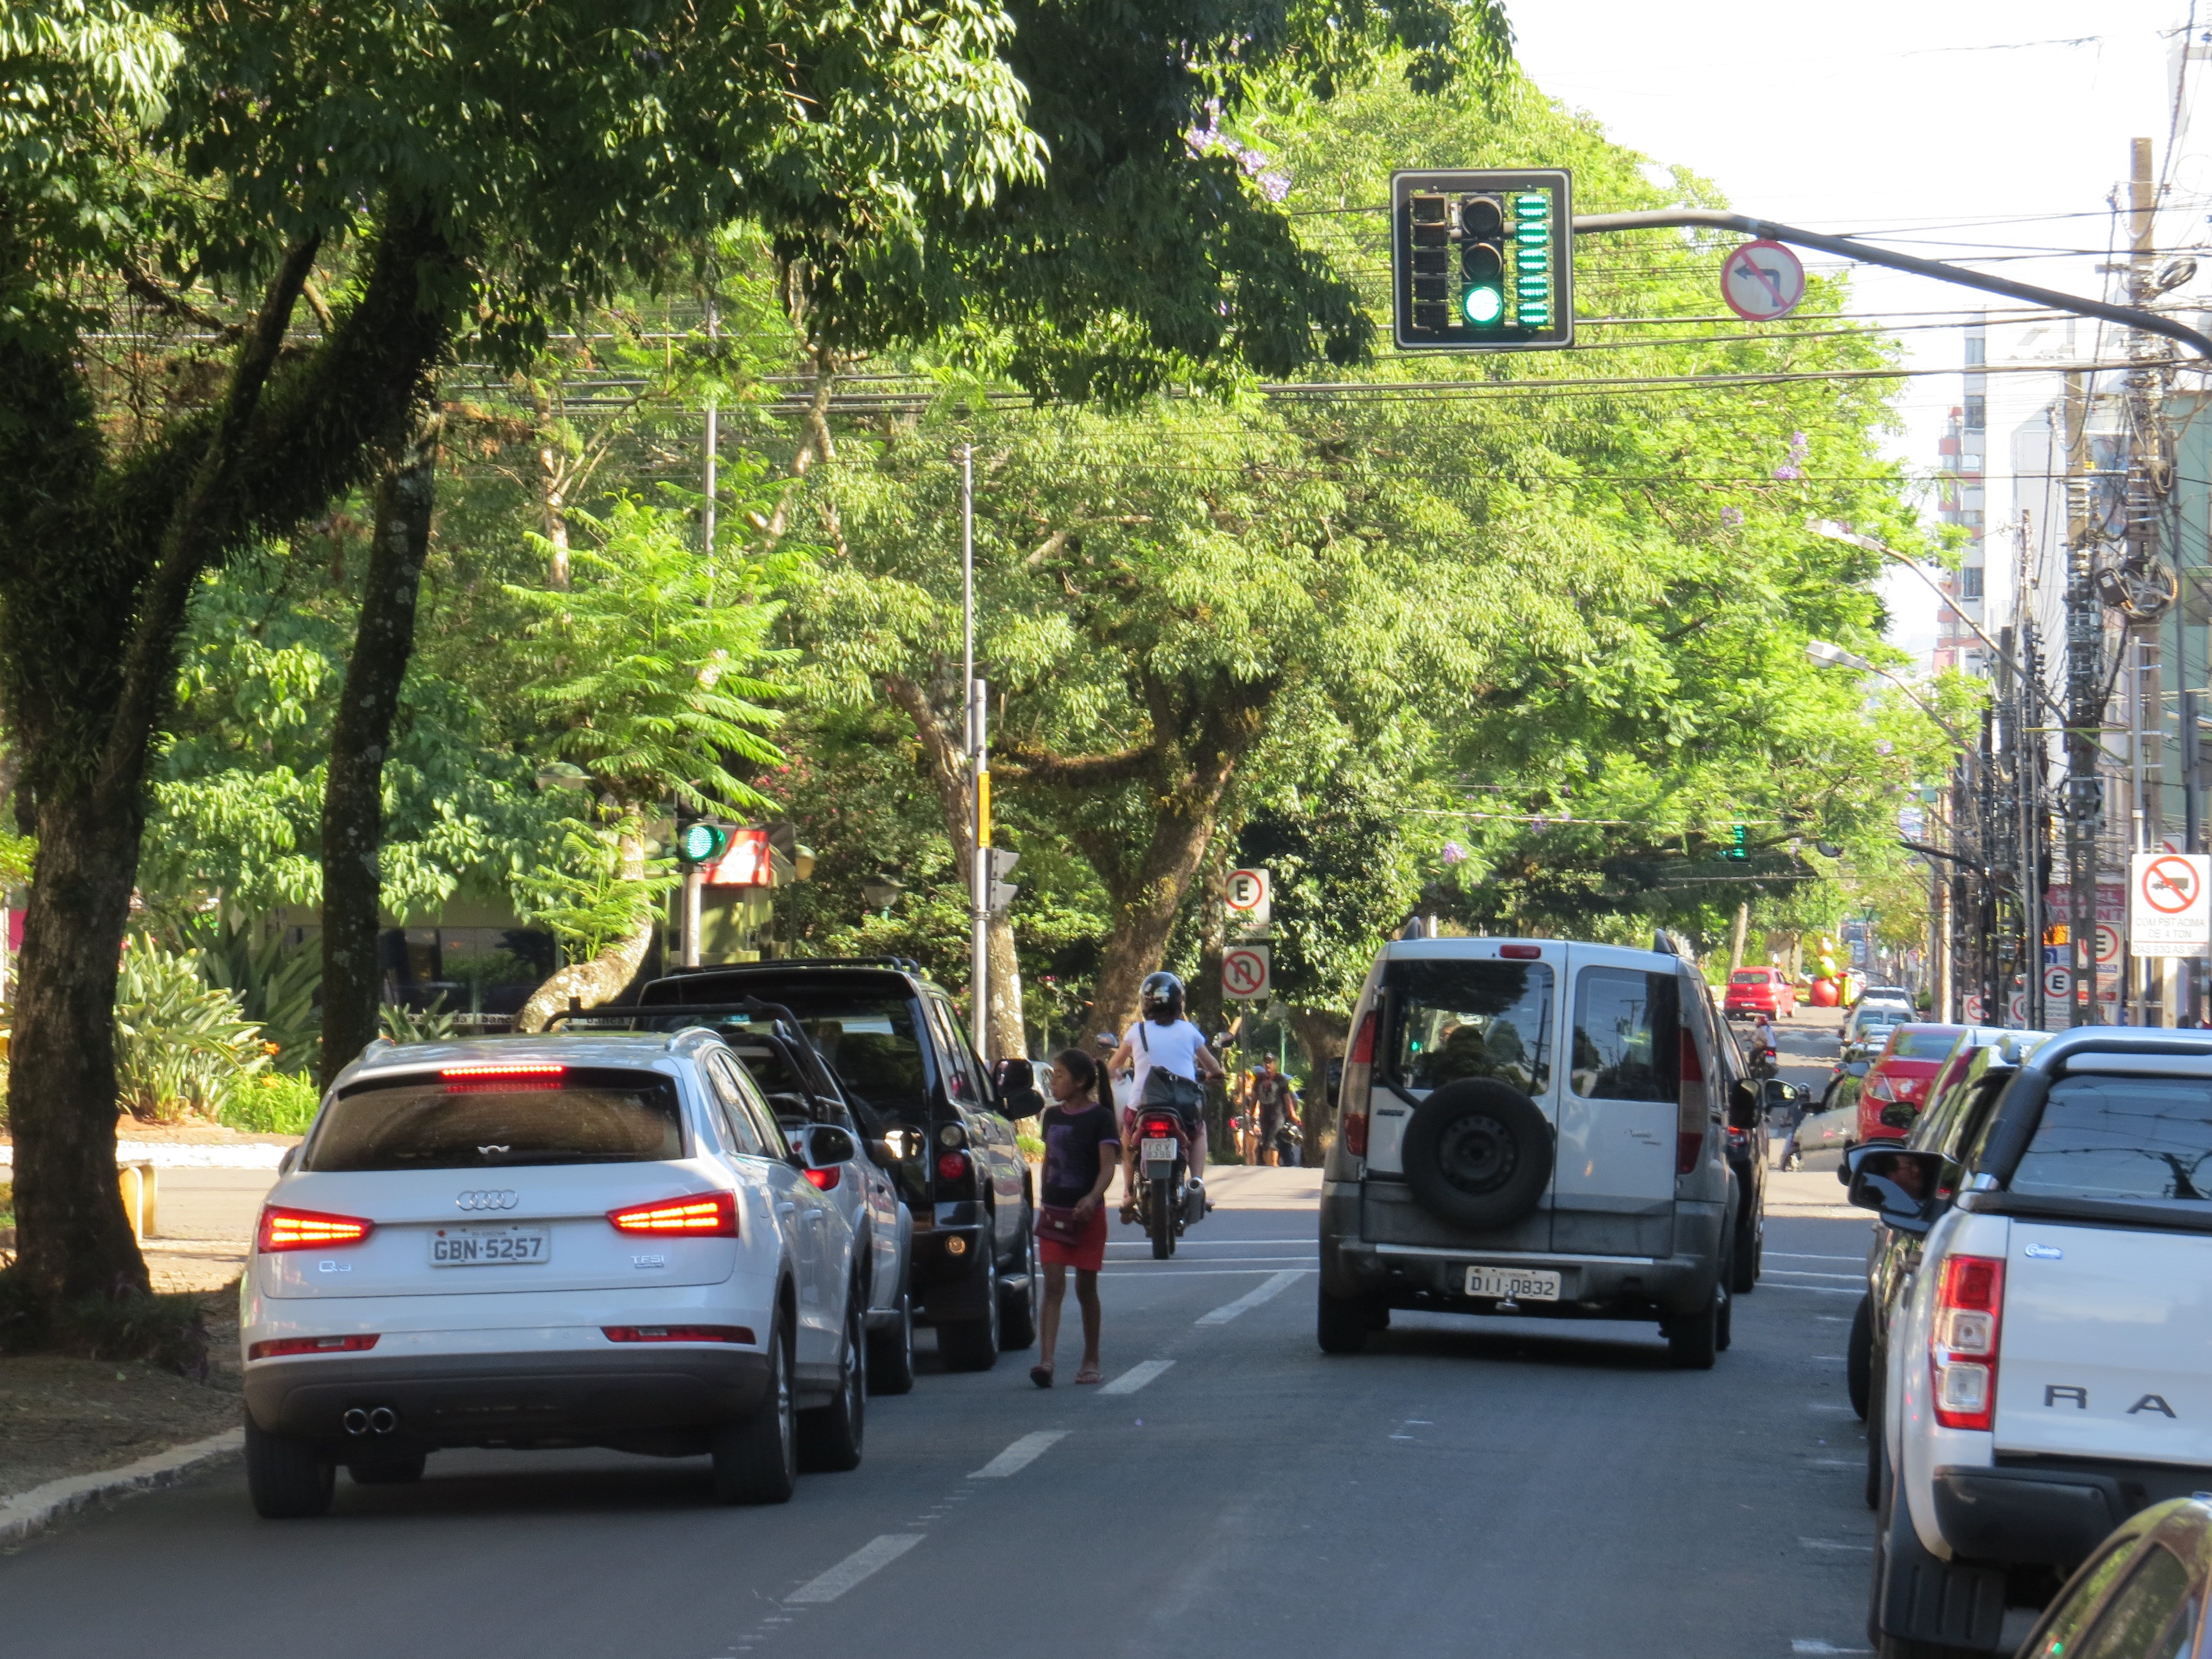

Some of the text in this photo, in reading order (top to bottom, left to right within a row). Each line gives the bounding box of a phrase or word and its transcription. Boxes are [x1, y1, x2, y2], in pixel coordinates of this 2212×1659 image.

[1236, 879, 1249, 901] E
[2135, 917, 2156, 927] COM
[2148, 928, 2161, 938] DE
[2052, 974, 2065, 989] E
[630, 1255, 665, 1264] TFSI
[319, 1260, 351, 1272] Q3
